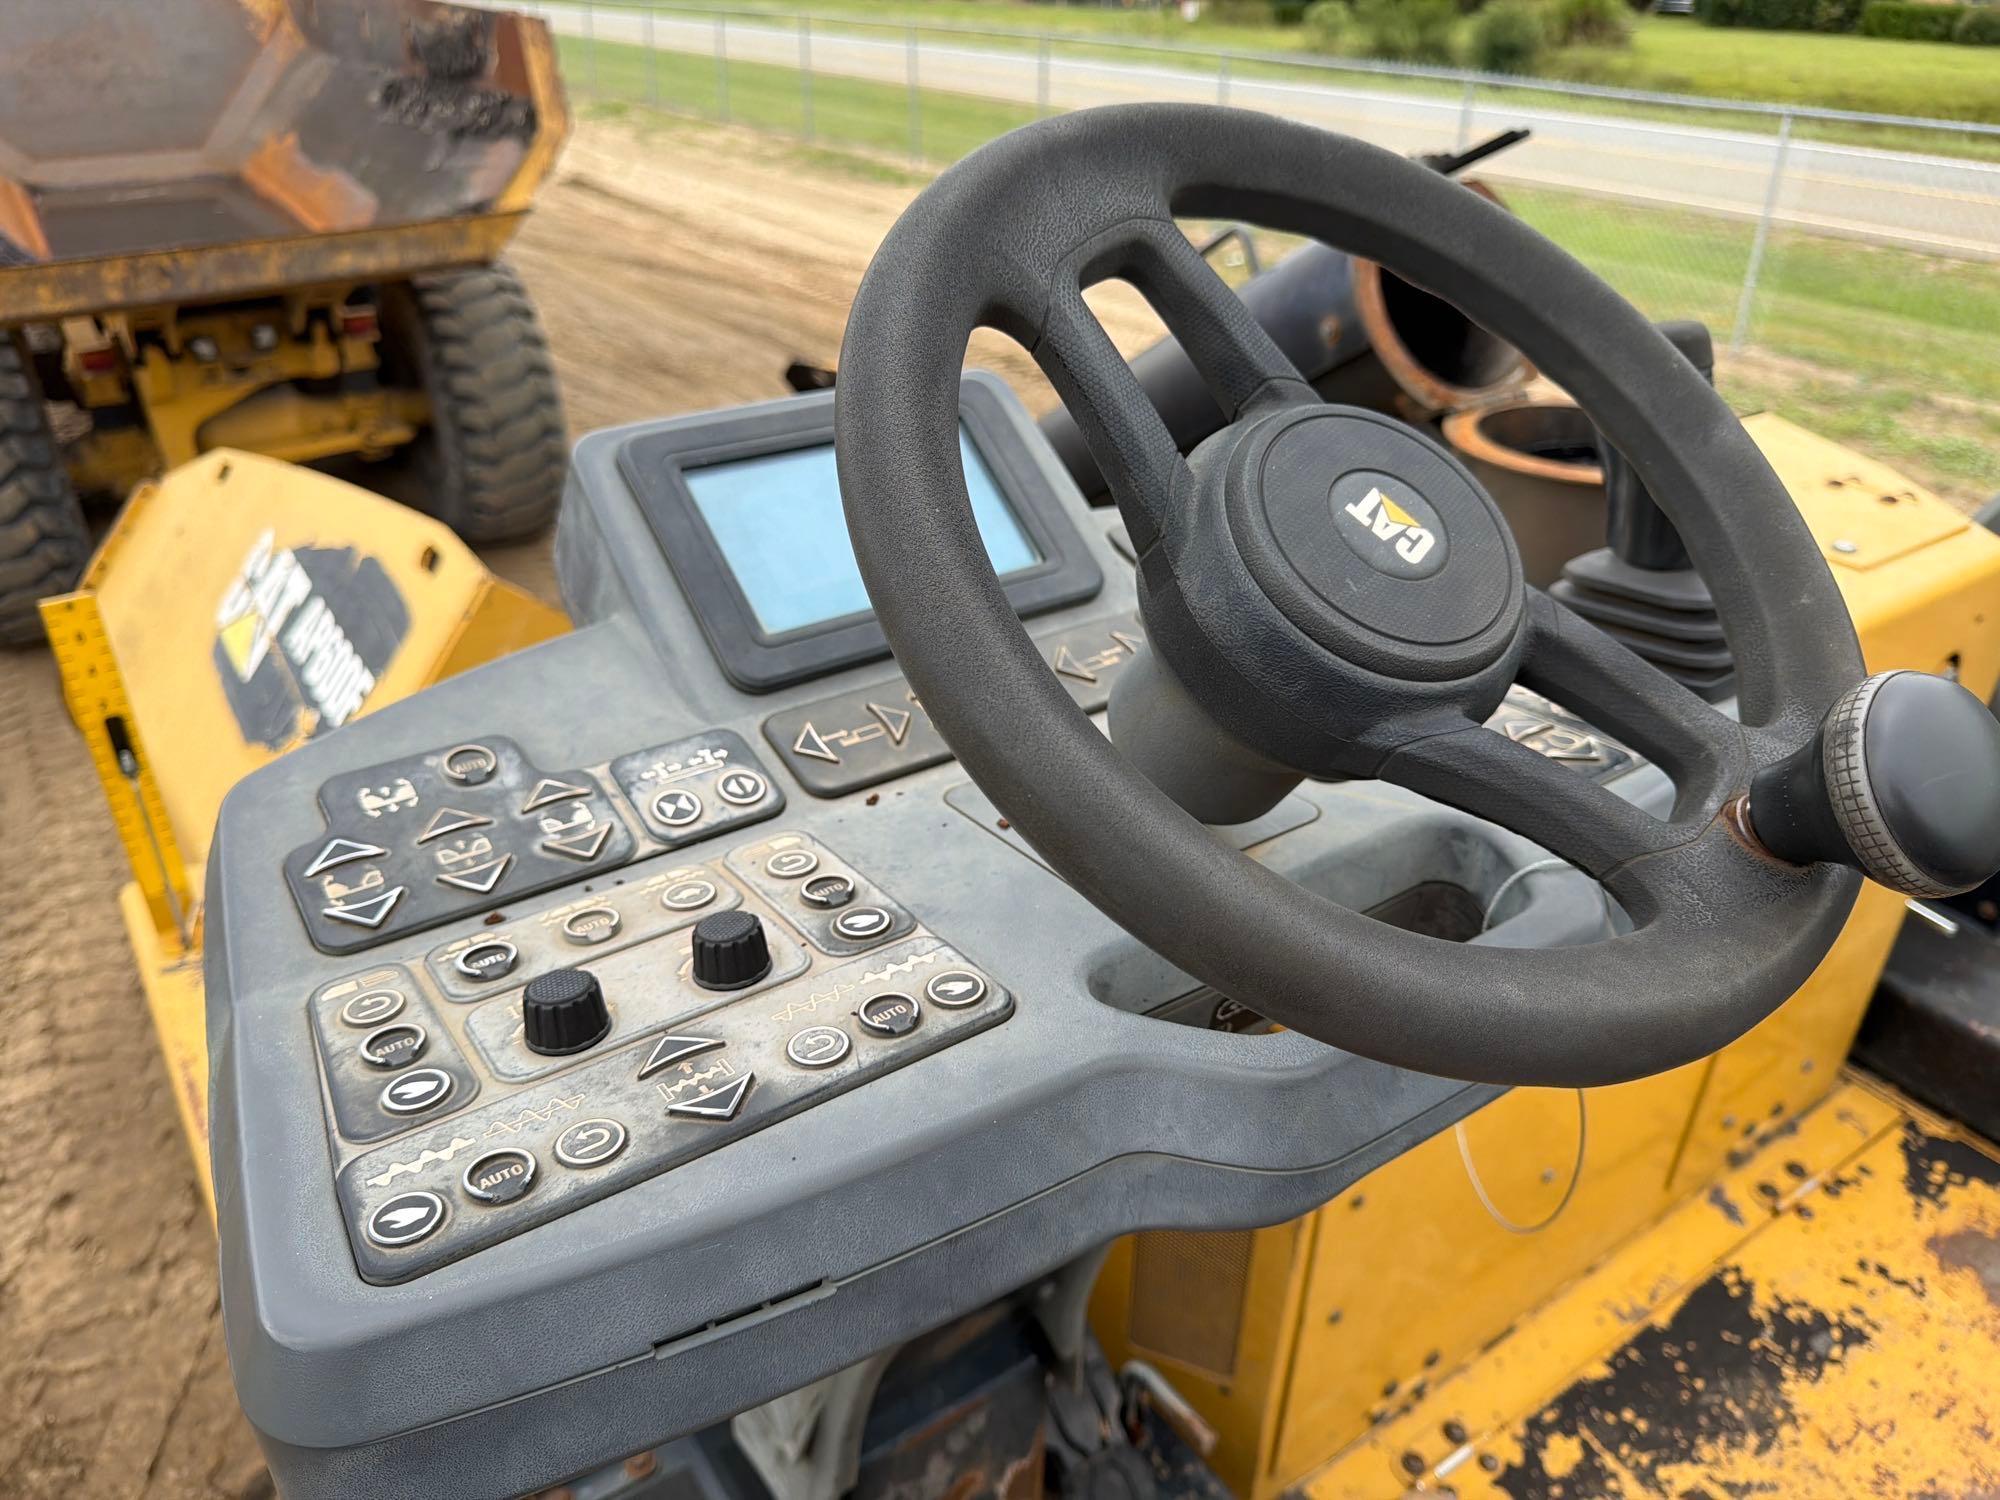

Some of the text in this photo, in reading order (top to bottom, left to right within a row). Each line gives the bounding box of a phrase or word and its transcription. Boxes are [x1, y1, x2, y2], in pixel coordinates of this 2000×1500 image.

[1345, 487, 1435, 564] CAT
[815, 883, 844, 897] AUTO
[471, 952, 507, 969] AUTO
[872, 1005, 907, 1025] AUTO
[376, 1037, 415, 1058] AUTO
[480, 1164, 524, 1190] AUTO
